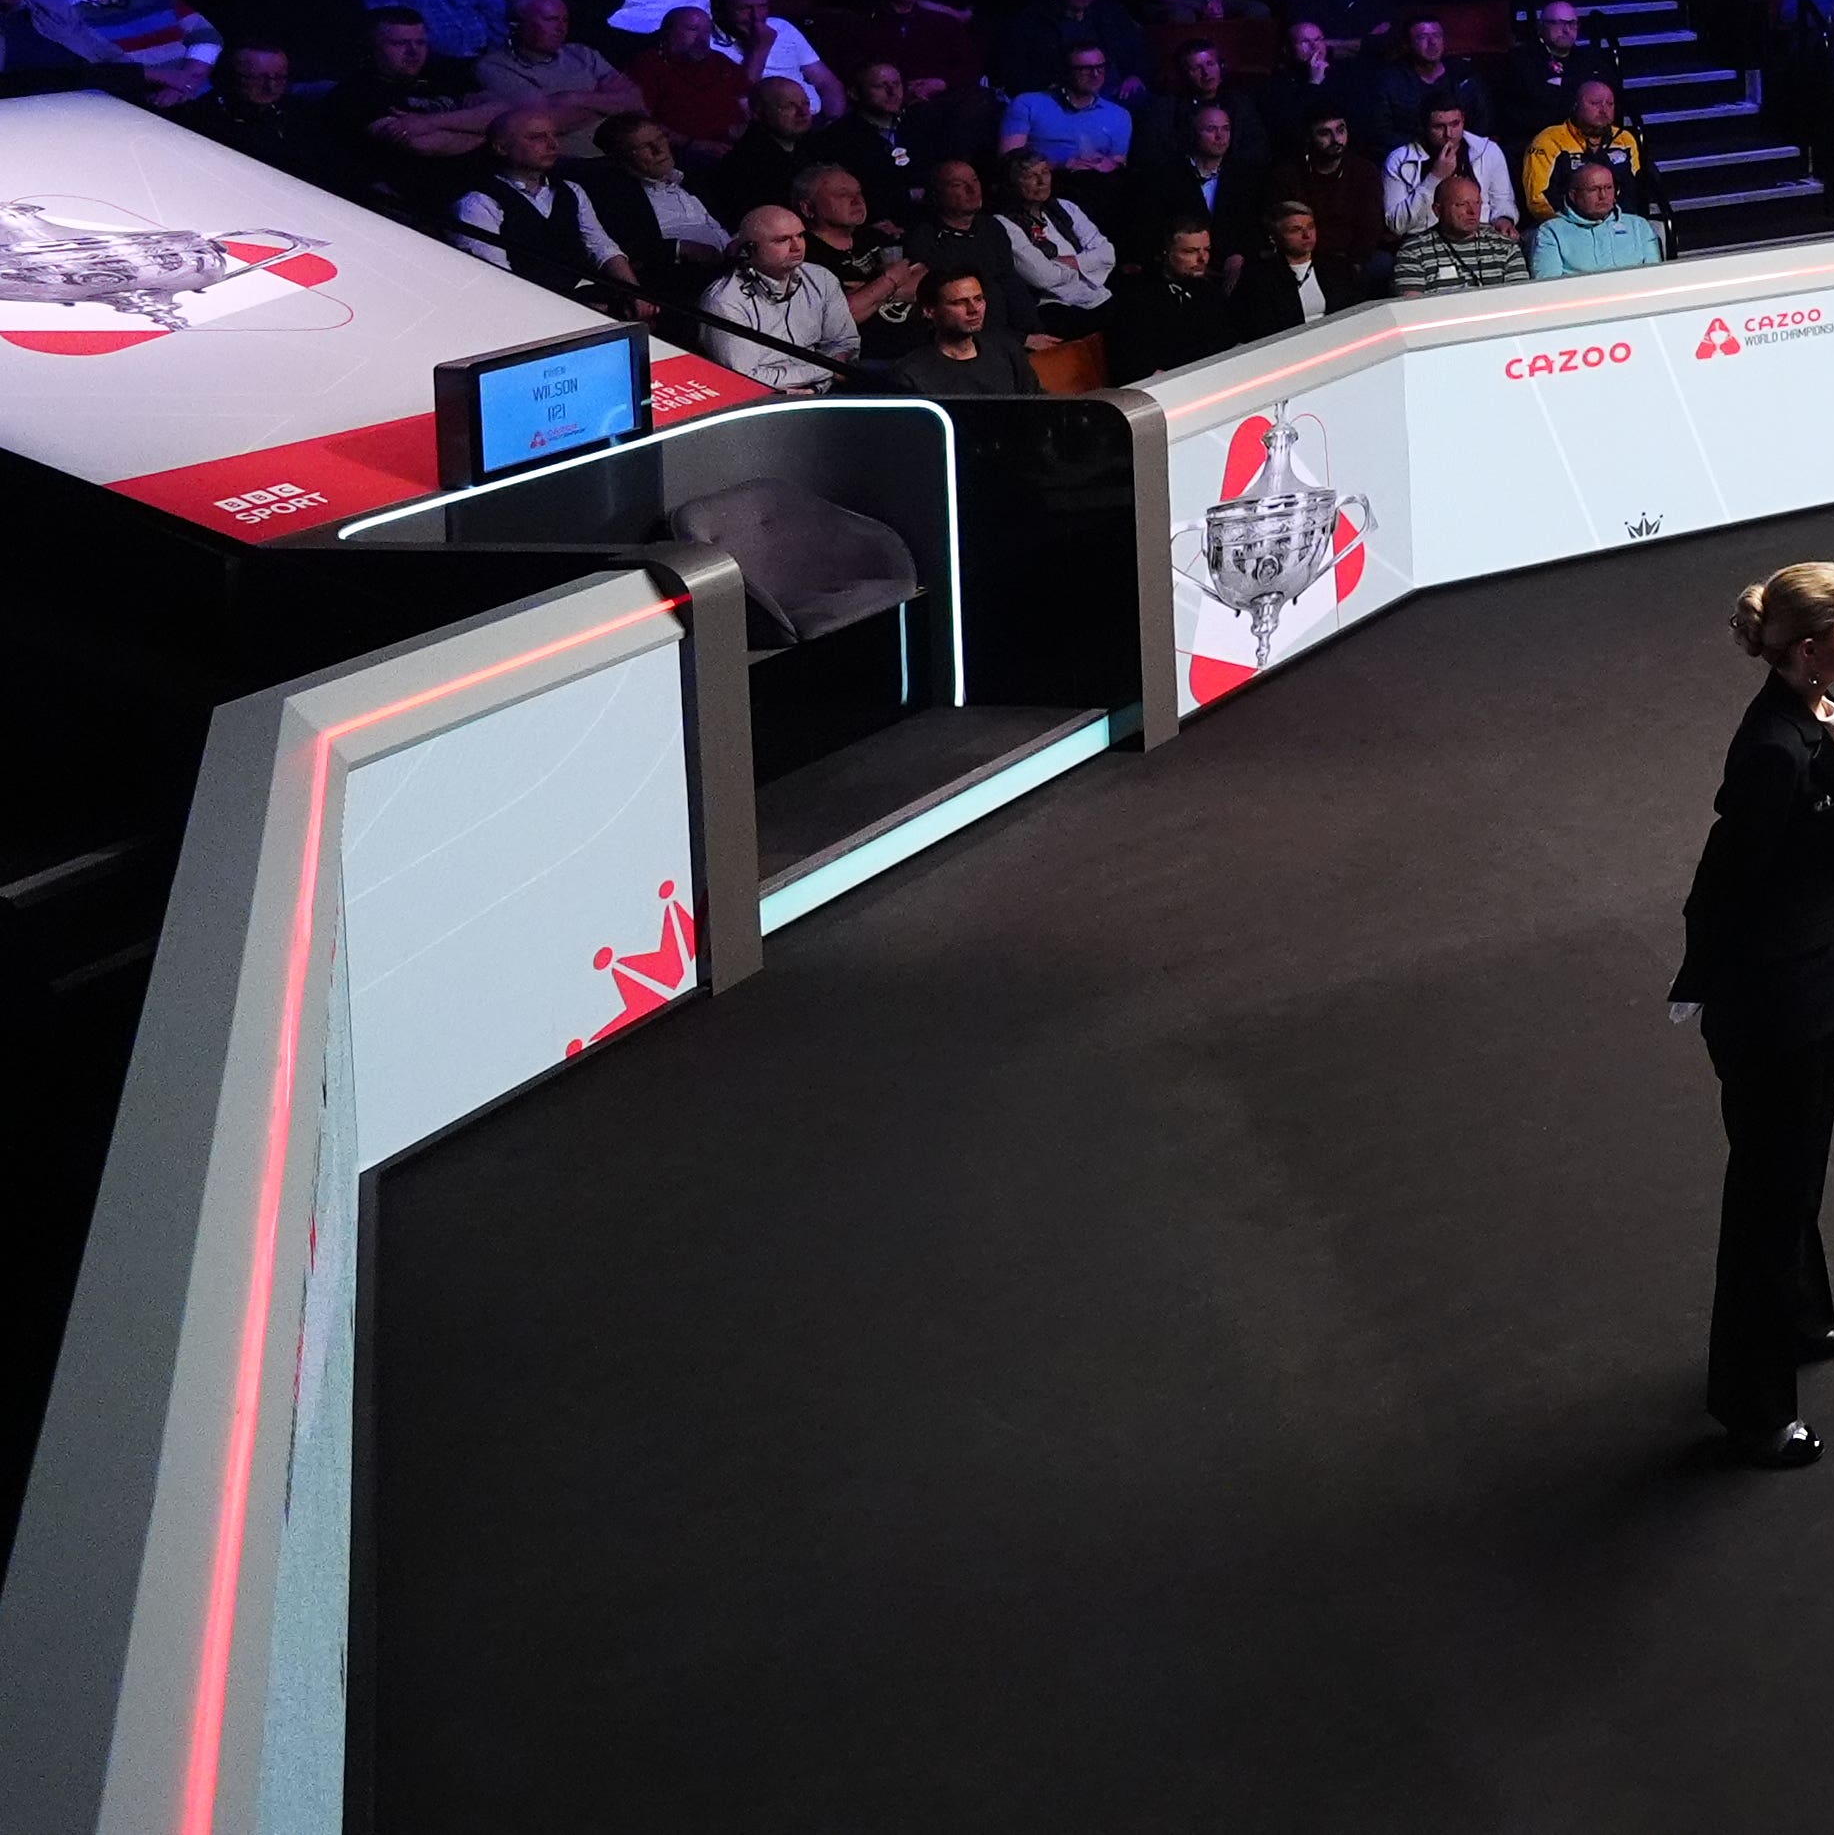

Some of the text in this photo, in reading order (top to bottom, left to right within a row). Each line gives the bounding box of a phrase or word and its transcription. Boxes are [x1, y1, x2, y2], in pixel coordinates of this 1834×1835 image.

[1743, 308, 1822, 333] CAZOO
[1744, 333, 1783, 347] WORLD
[1504, 341, 1632, 381] CAZOO
[532, 377, 578, 401] WILSON
[651, 388, 721, 412] CROWN
[213, 482, 306, 513] BBC
[235, 491, 328, 525] SPORT
